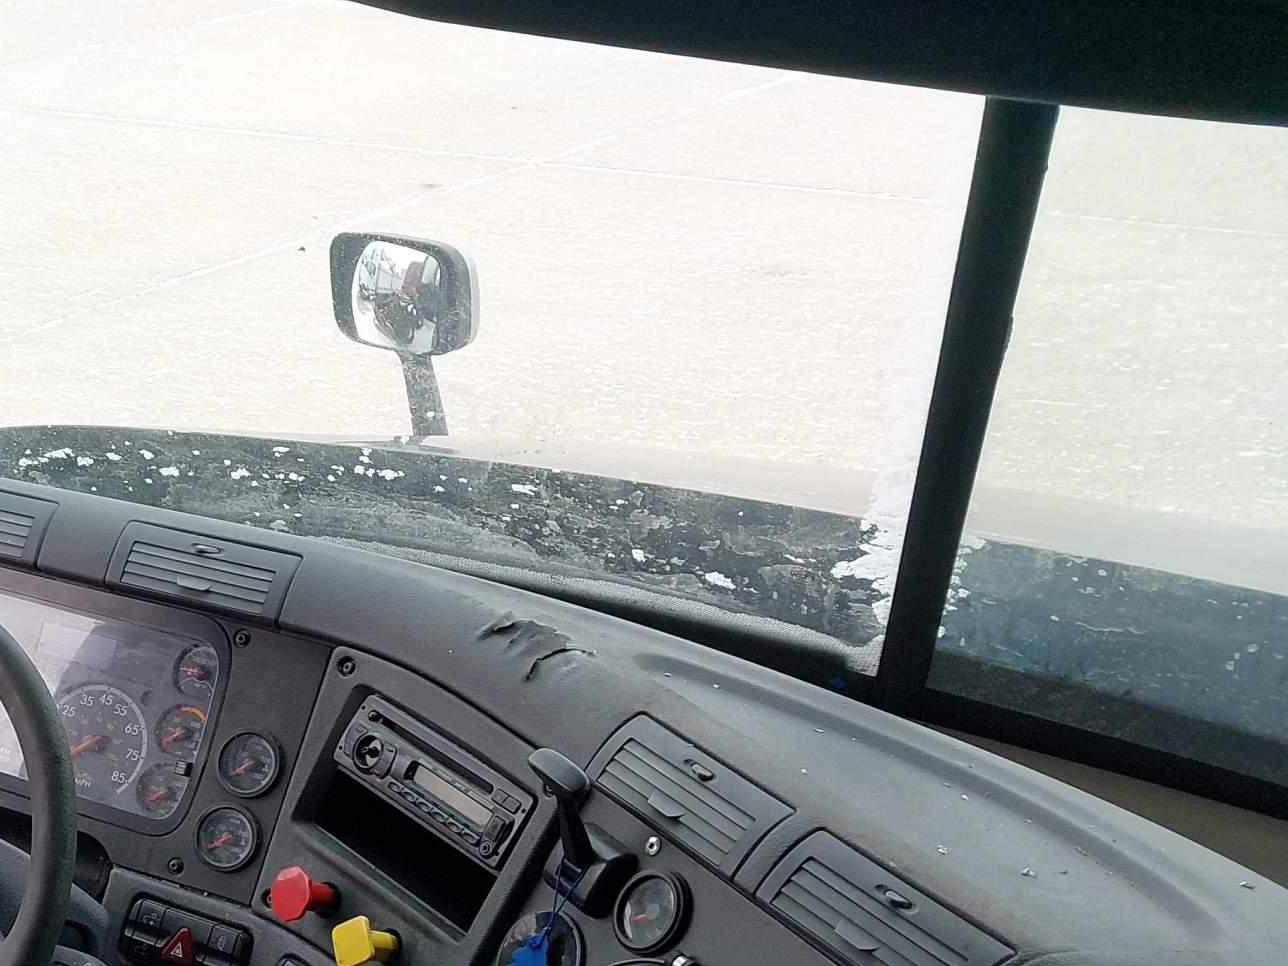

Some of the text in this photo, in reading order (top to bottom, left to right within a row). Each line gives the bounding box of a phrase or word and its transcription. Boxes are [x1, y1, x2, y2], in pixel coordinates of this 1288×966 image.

[80, 695, 94, 706] 35
[99, 694, 114, 706] 45
[62, 705, 76, 717] 25
[113, 704, 128, 716] 55
[125, 724, 139, 735] 65
[125, 749, 140, 761] 75
[75, 778, 91, 787] MPH
[111, 771, 126, 783] 85
